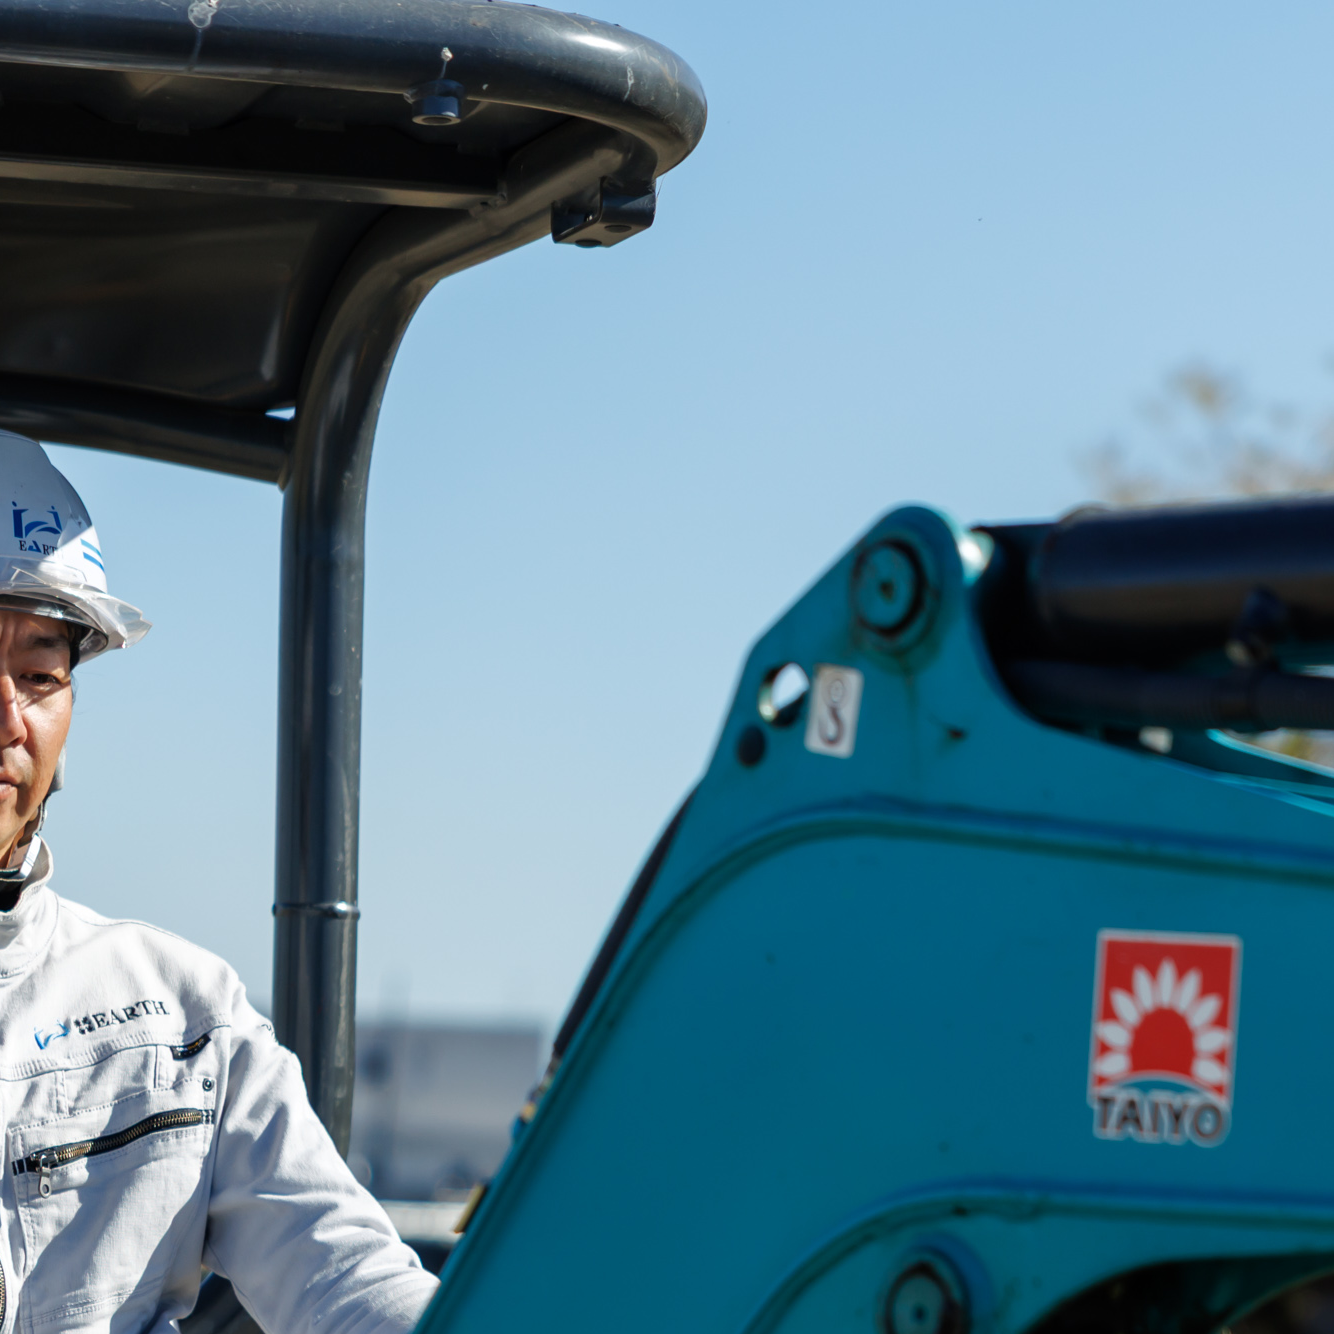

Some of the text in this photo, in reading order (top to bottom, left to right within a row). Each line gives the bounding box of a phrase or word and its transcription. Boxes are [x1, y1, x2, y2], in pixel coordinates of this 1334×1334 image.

[19, 540, 63, 558] EART
[92, 1000, 170, 1028] EARTH
[1097, 1097, 1223, 1140] TAIYO
